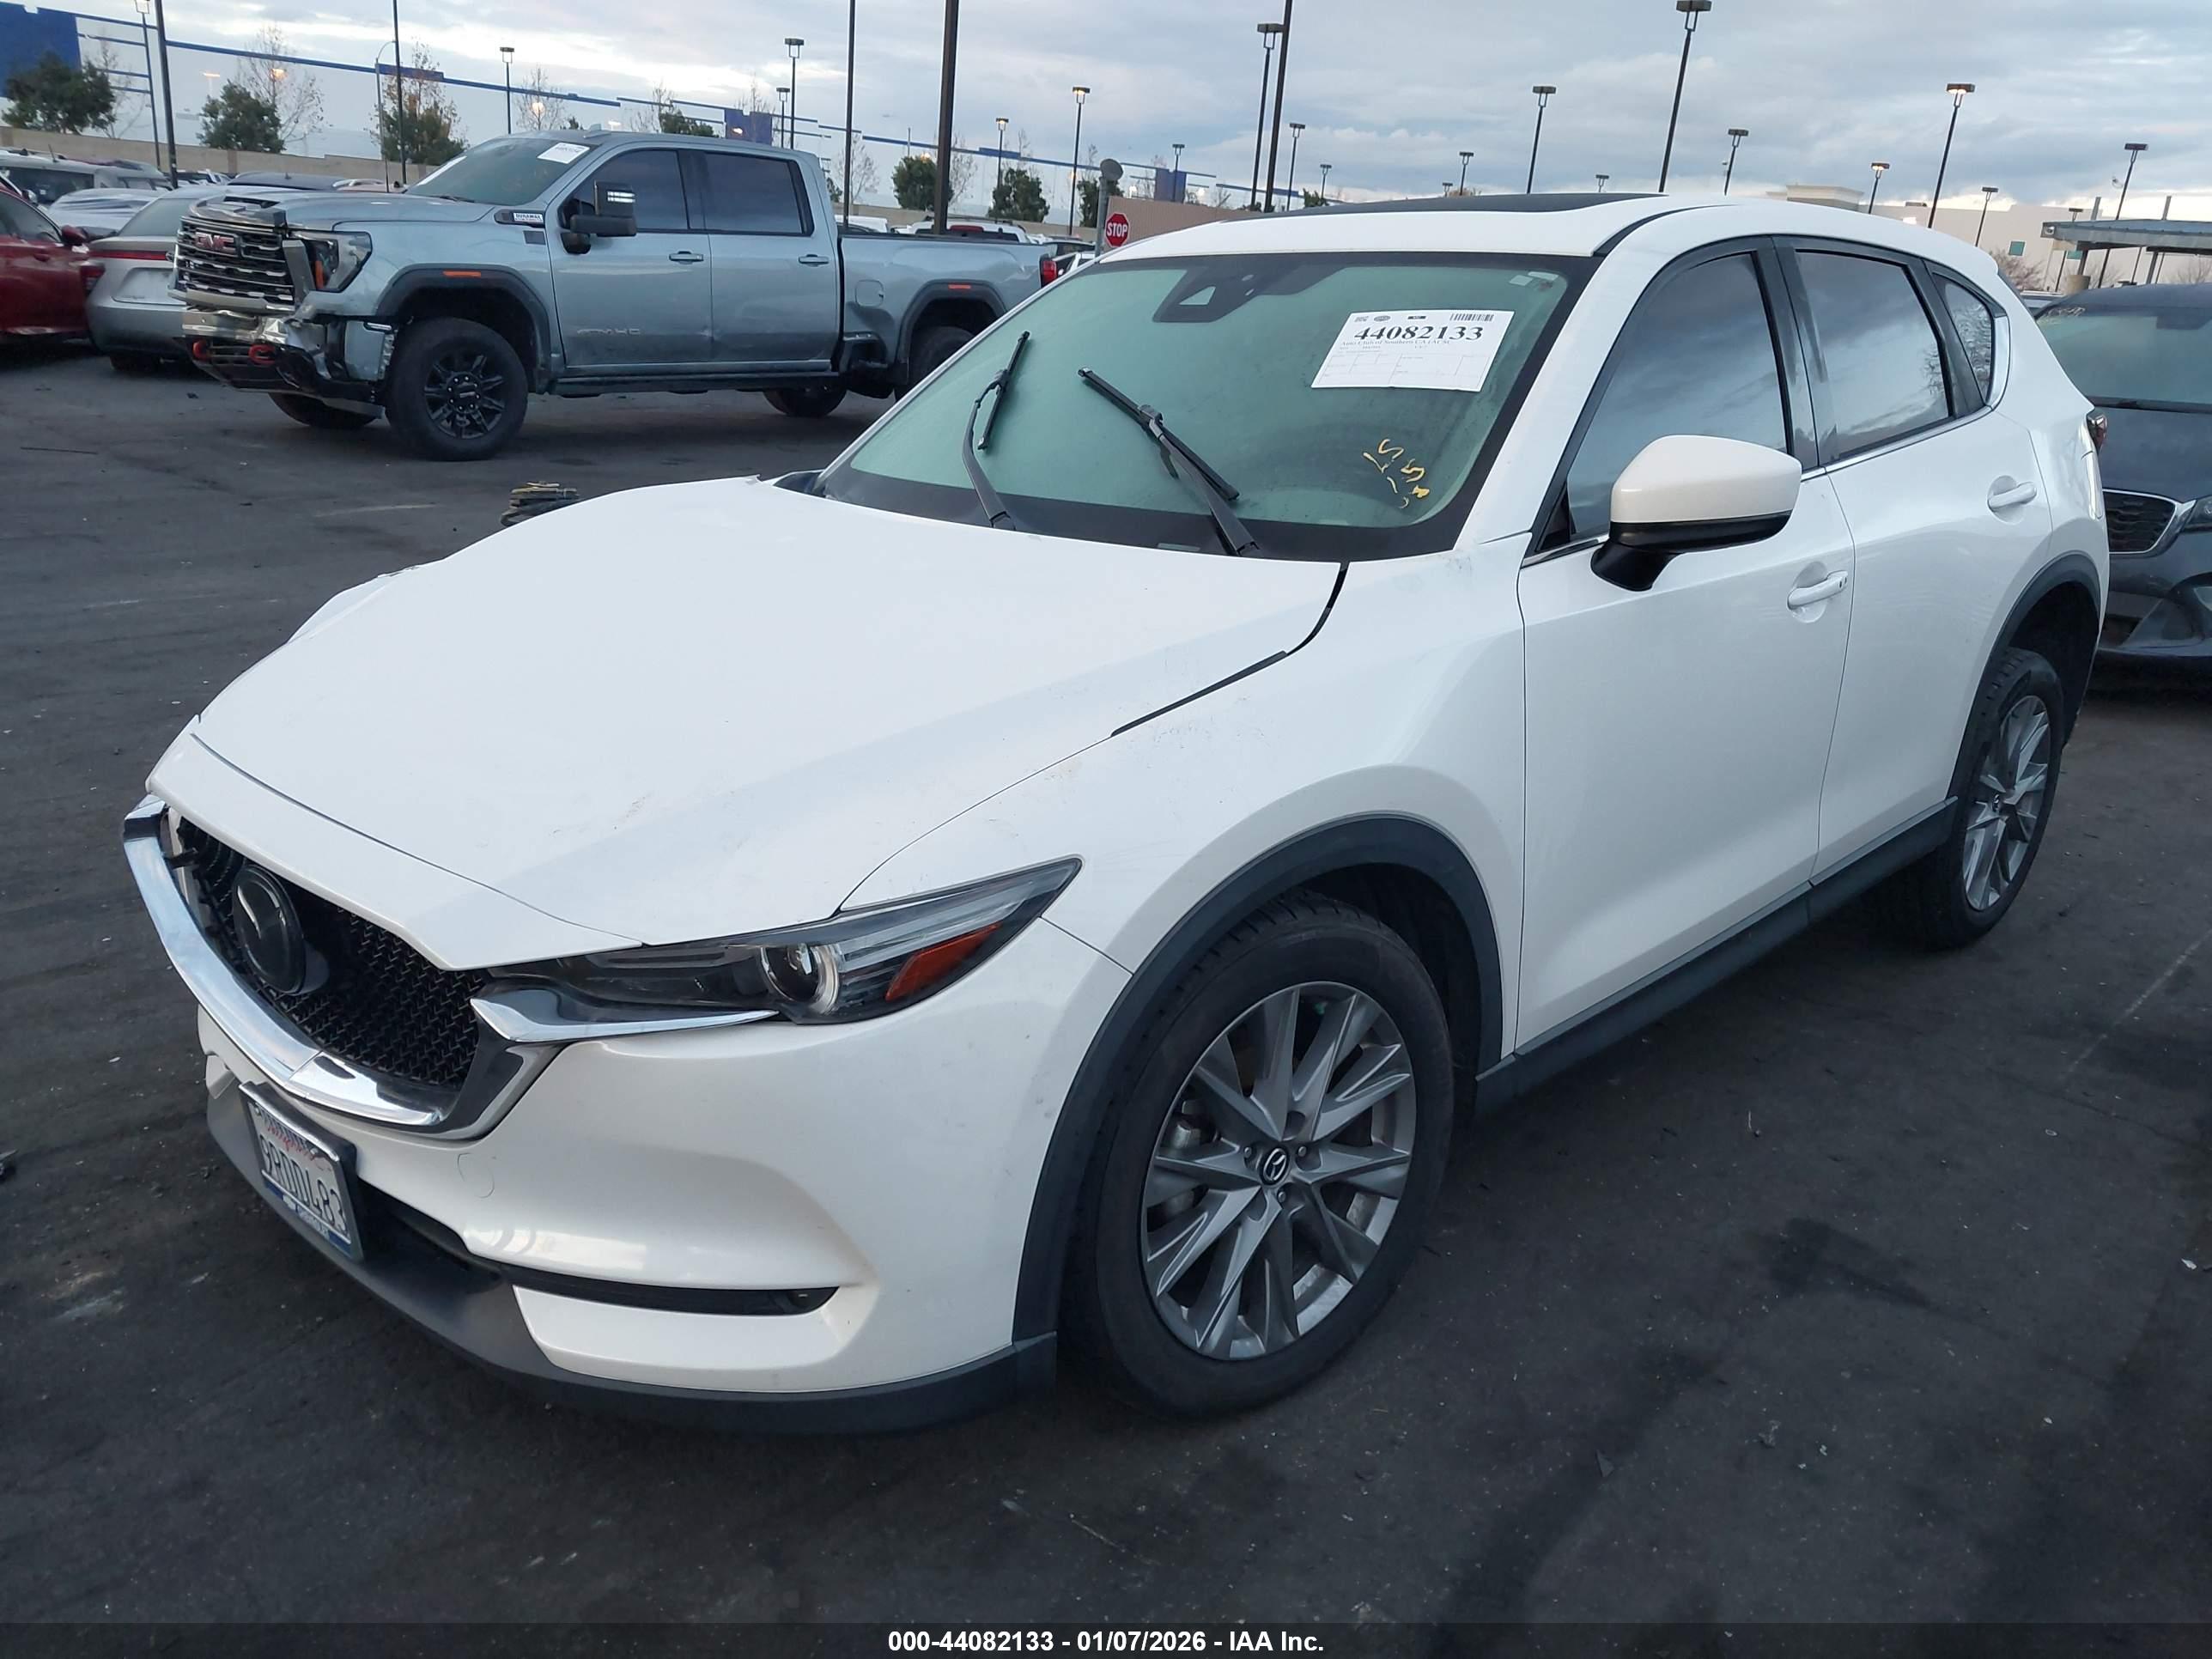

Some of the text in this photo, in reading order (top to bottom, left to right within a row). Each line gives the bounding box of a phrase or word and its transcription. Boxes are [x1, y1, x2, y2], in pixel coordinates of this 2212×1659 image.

[1107, 222, 1128, 237] STOP
[193, 231, 236, 256] GMC
[1354, 325, 1484, 341] 44082133
